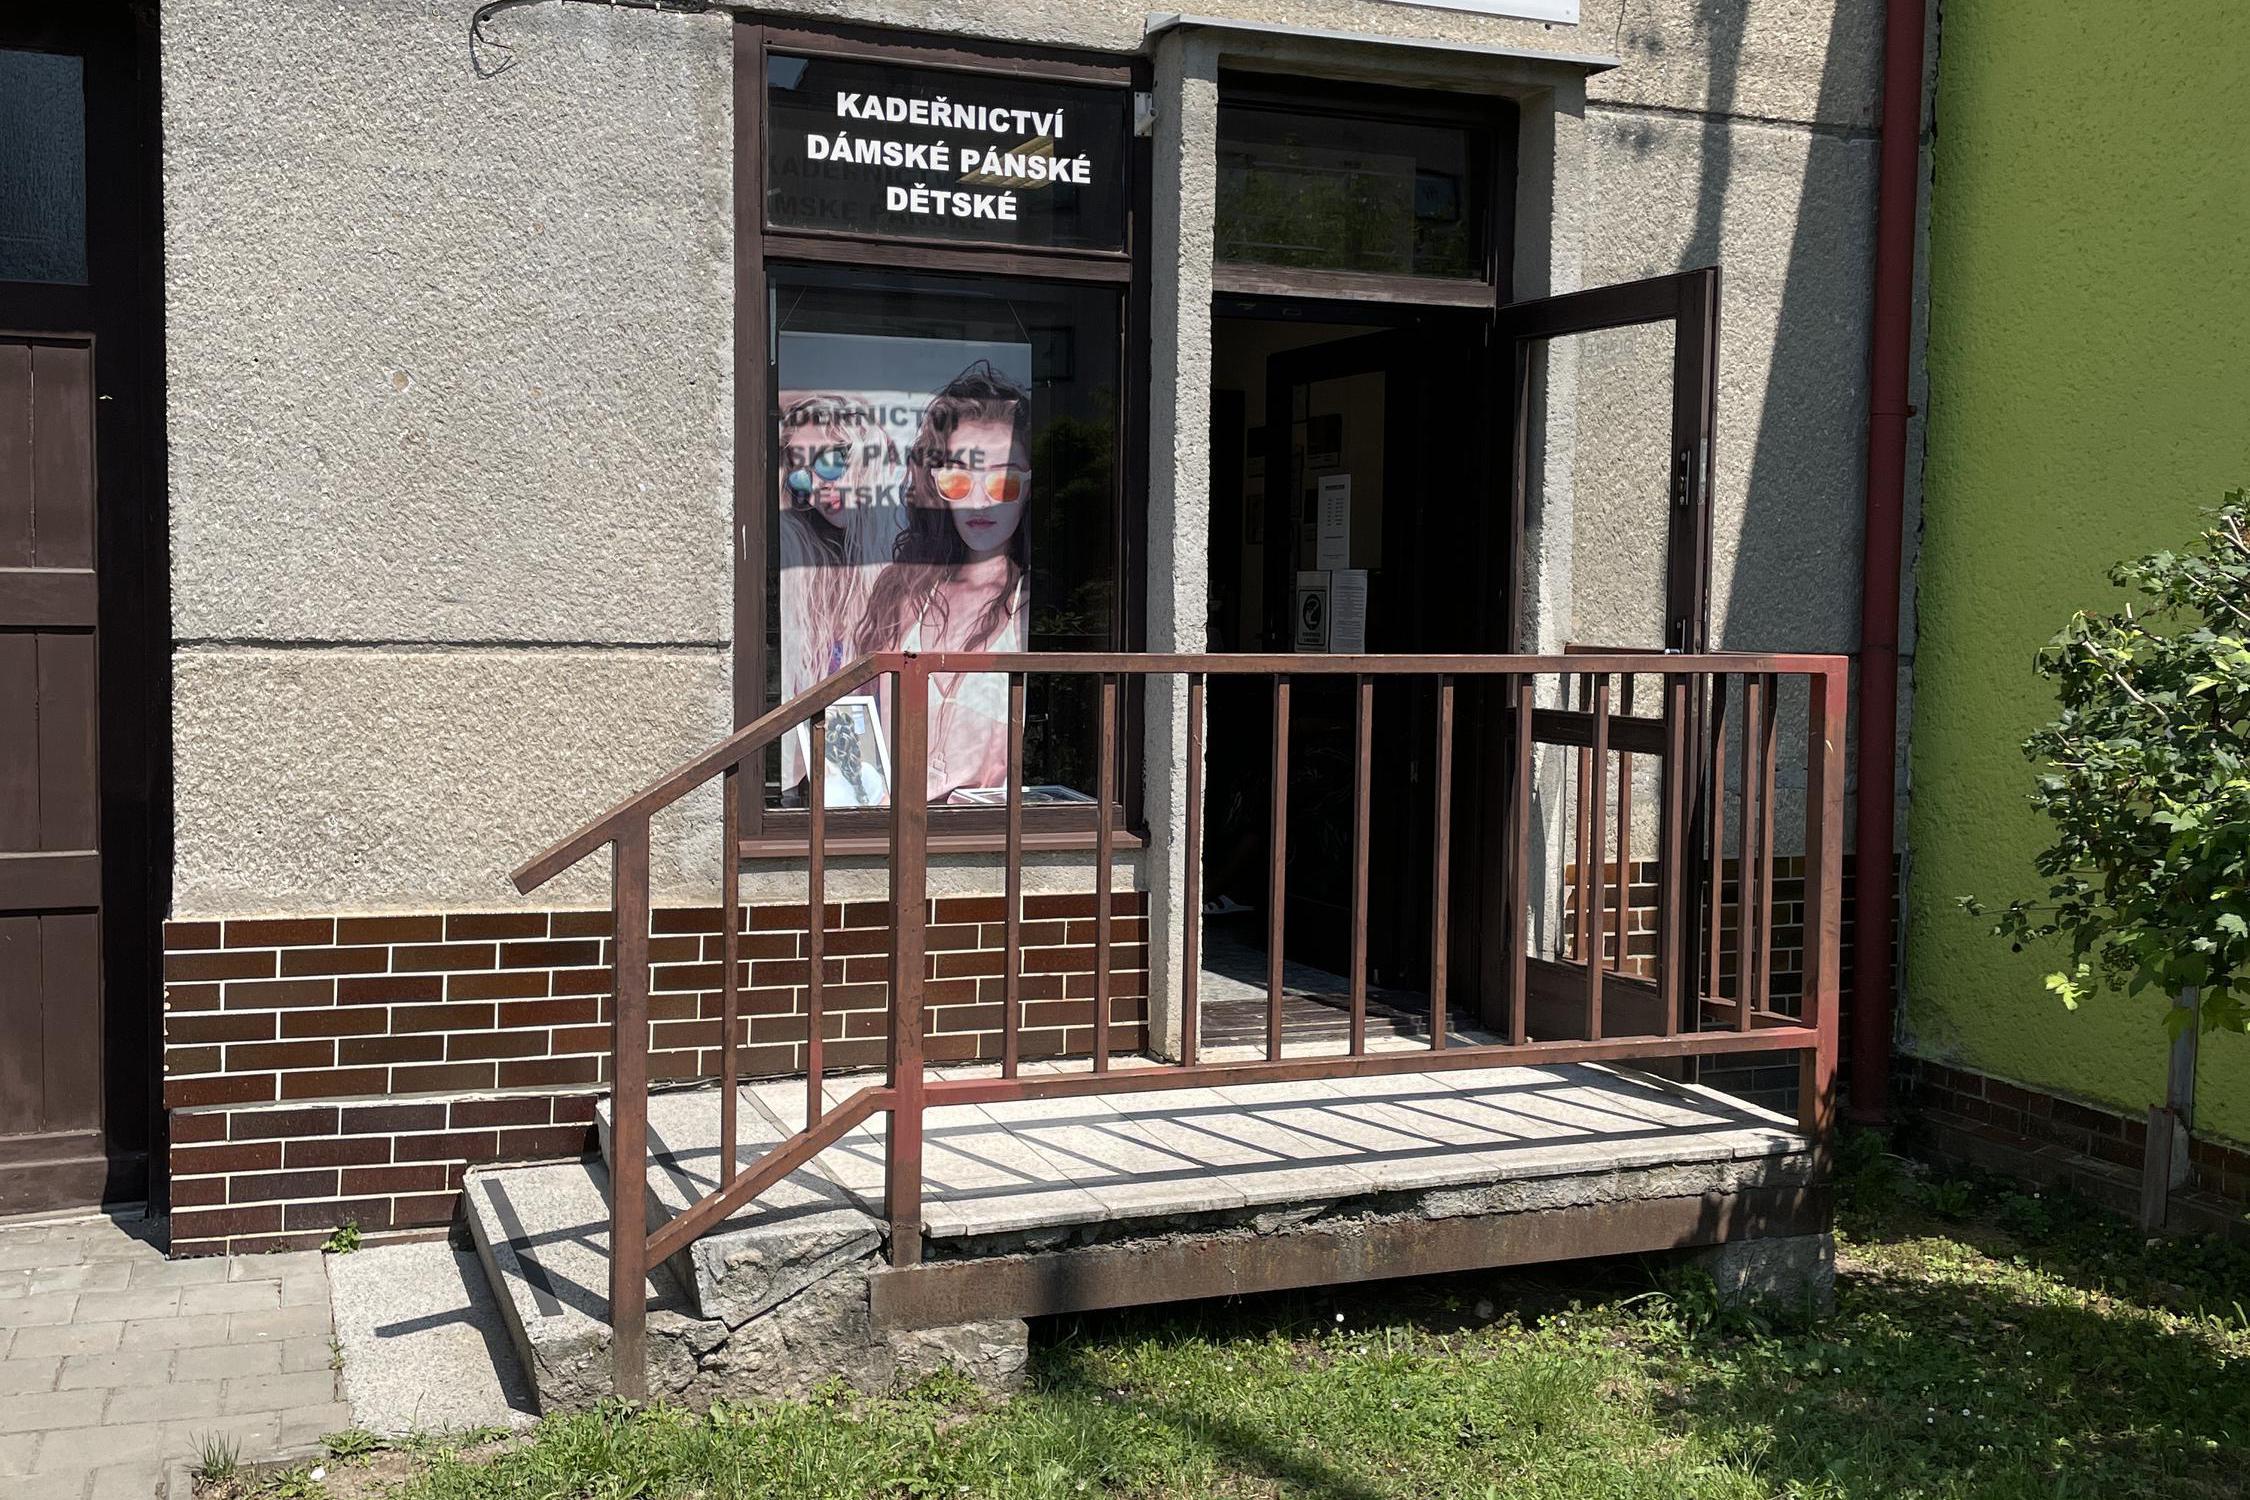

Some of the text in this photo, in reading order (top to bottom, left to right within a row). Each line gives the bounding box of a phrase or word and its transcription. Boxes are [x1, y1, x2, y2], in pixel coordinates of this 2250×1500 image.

[837, 91, 1063, 138] KADEŘNICTVÍ
[807, 131, 950, 171] DÁMSKÉ
[960, 146, 1091, 184] PÁNSKÉ
[887, 182, 1017, 221] DĚTSKÉ
